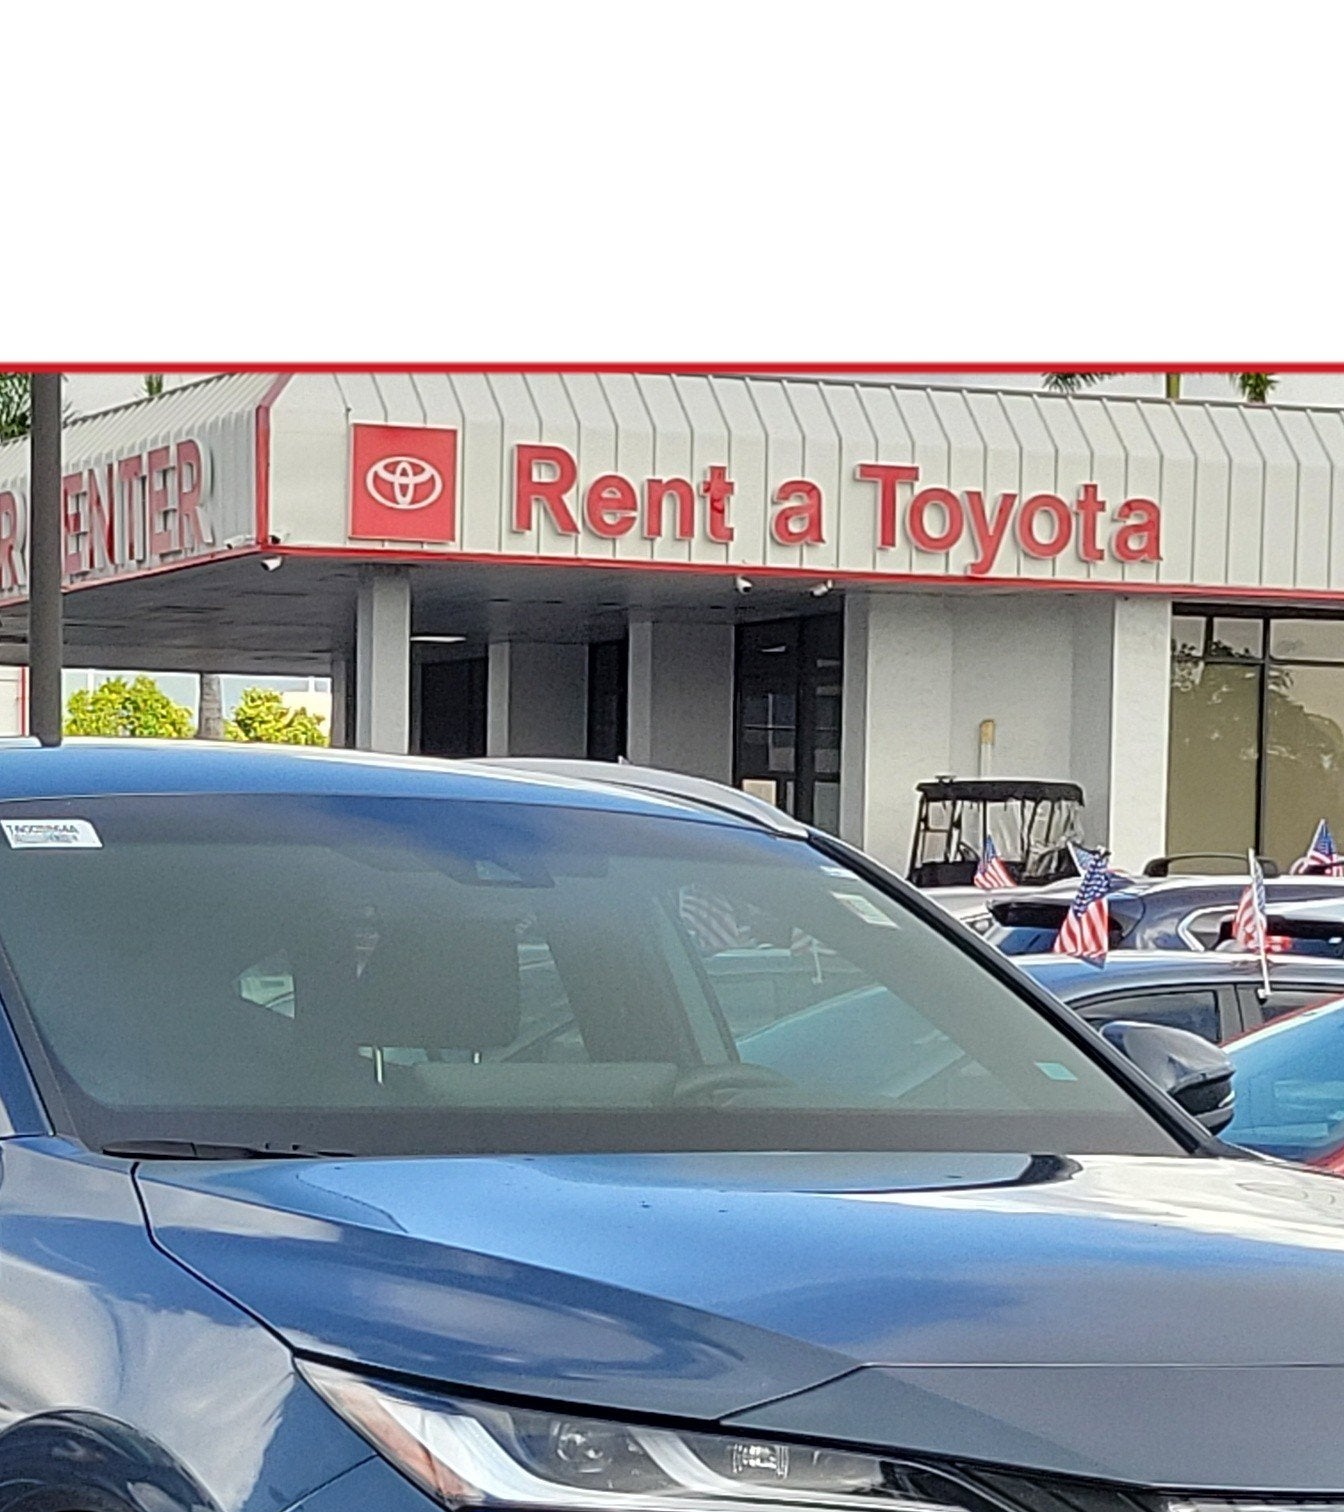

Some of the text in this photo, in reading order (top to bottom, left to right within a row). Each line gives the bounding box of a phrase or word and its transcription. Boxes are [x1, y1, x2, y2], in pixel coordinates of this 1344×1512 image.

[61, 437, 213, 578] ENTER
[513, 444, 1163, 575] Rent a Toyota
